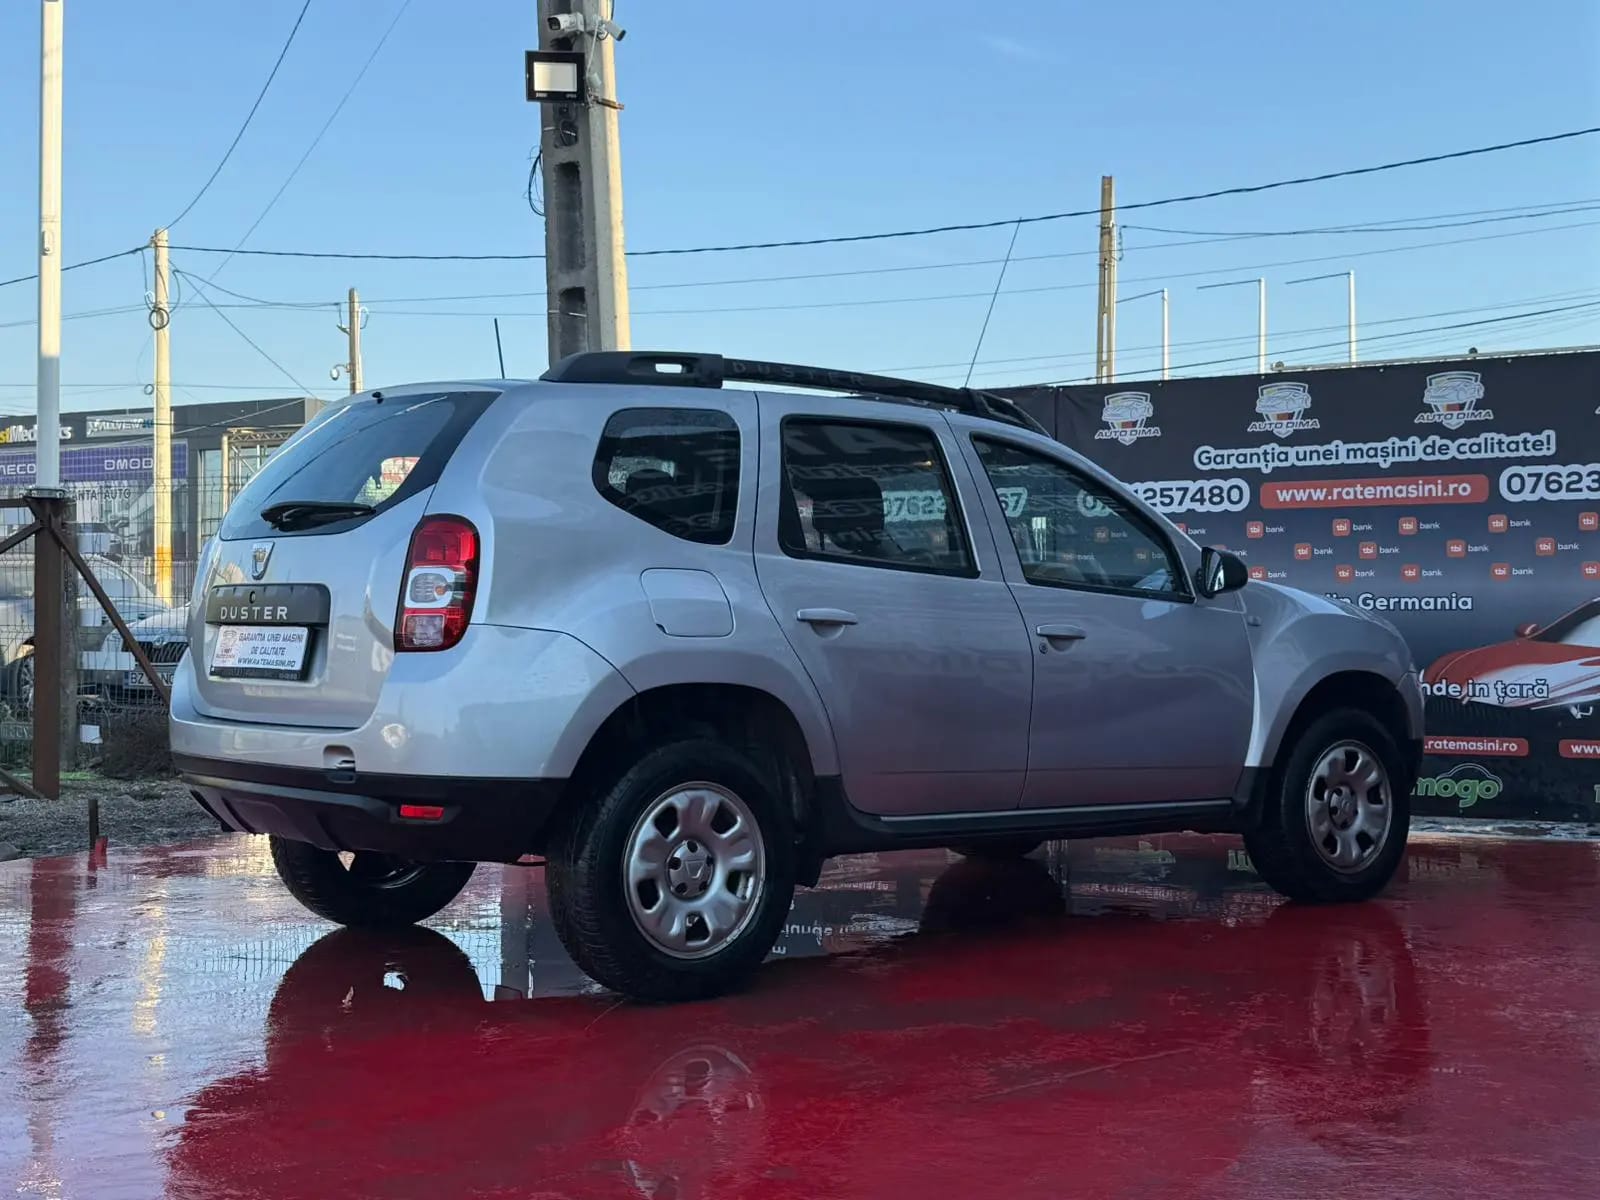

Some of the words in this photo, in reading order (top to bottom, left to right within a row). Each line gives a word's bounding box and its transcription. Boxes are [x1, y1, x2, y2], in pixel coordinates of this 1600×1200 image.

[733, 361, 863, 386] DUSTER
[1415, 412, 1454, 423] AUTO
[1456, 410, 1494, 421] DIMA
[1249, 421, 1283, 432] AUTO
[1285, 419, 1319, 430] DIMA
[1095, 429, 1128, 439] AUTO
[1129, 427, 1160, 437] DIMA
[1197, 449, 1290, 470] Garanția
[1295, 445, 1340, 463] unei
[1346, 440, 1417, 465] mașini
[1422, 439, 1450, 457] de
[1456, 434, 1552, 455] calitate!
[1276, 480, 1472, 502] www.ratemasini.ro
[1506, 470, 1600, 496] 07623
[1352, 523, 1373, 531] bank
[1419, 522, 1440, 530] bank
[1510, 519, 1532, 527] bank
[1379, 546, 1399, 554] bank
[1467, 544, 1489, 552] bank
[1557, 542, 1579, 550] bank
[1313, 547, 1333, 555] bank
[1267, 570, 1287, 578] bank
[1354, 569, 1375, 577] bank
[1421, 568, 1442, 576] bank
[1512, 567, 1534, 575] bank
[1358, 593, 1473, 610] Germania
[220, 606, 288, 620] DUSTER
[1419, 679, 1464, 697] nde
[1467, 680, 1490, 697] in
[1494, 679, 1549, 704] țară
[1424, 738, 1518, 752] .ratemasini.ro
